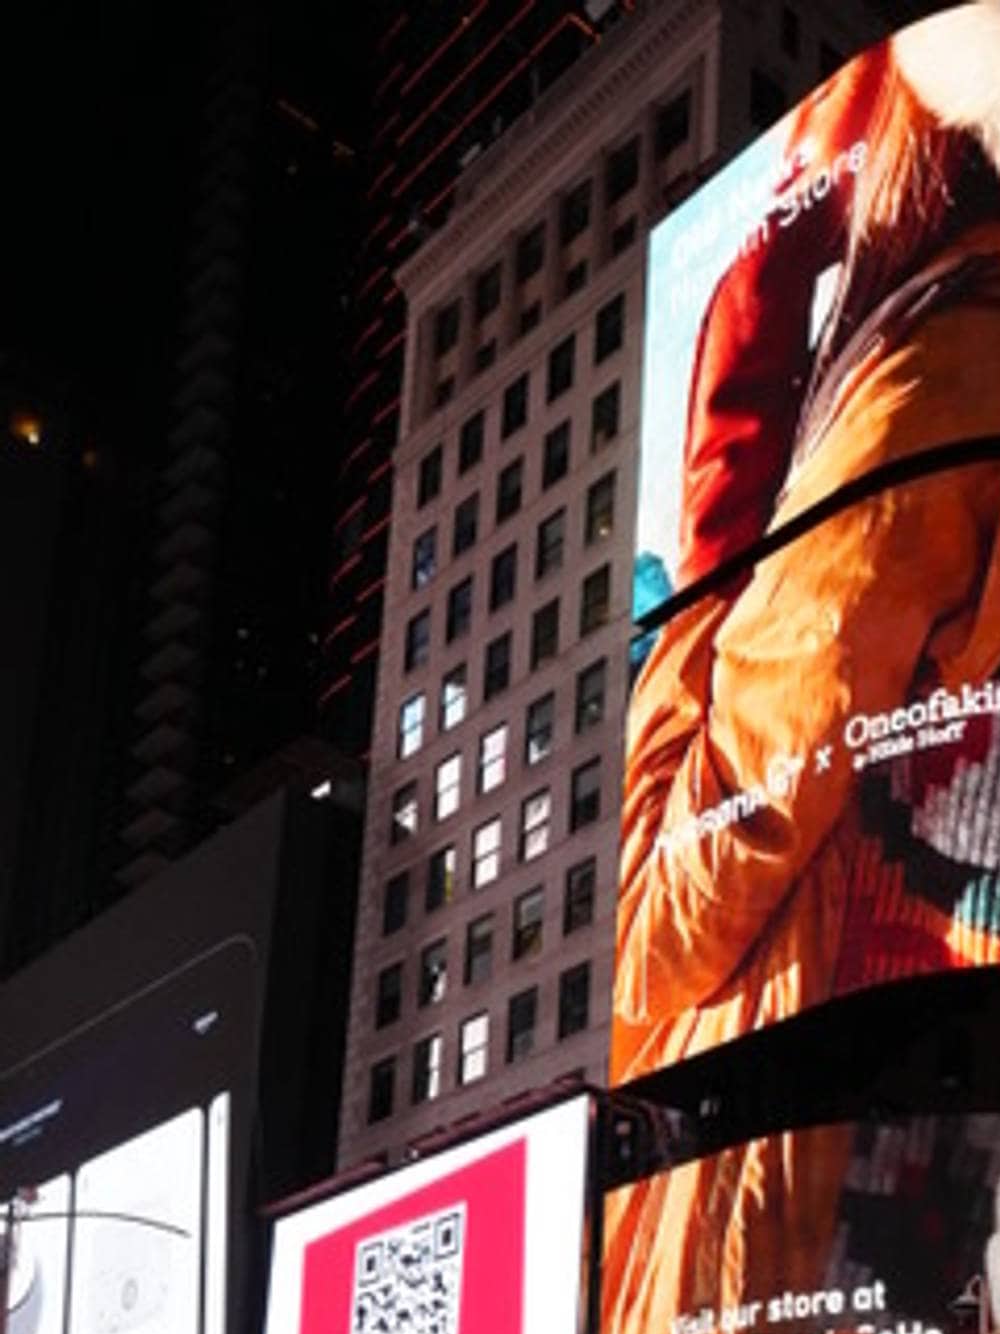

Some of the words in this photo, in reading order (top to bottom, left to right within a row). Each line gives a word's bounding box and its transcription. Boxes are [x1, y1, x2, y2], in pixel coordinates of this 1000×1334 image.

[721, 1301, 762, 1331] our
[769, 1289, 844, 1322] store
[852, 1279, 885, 1310] at
